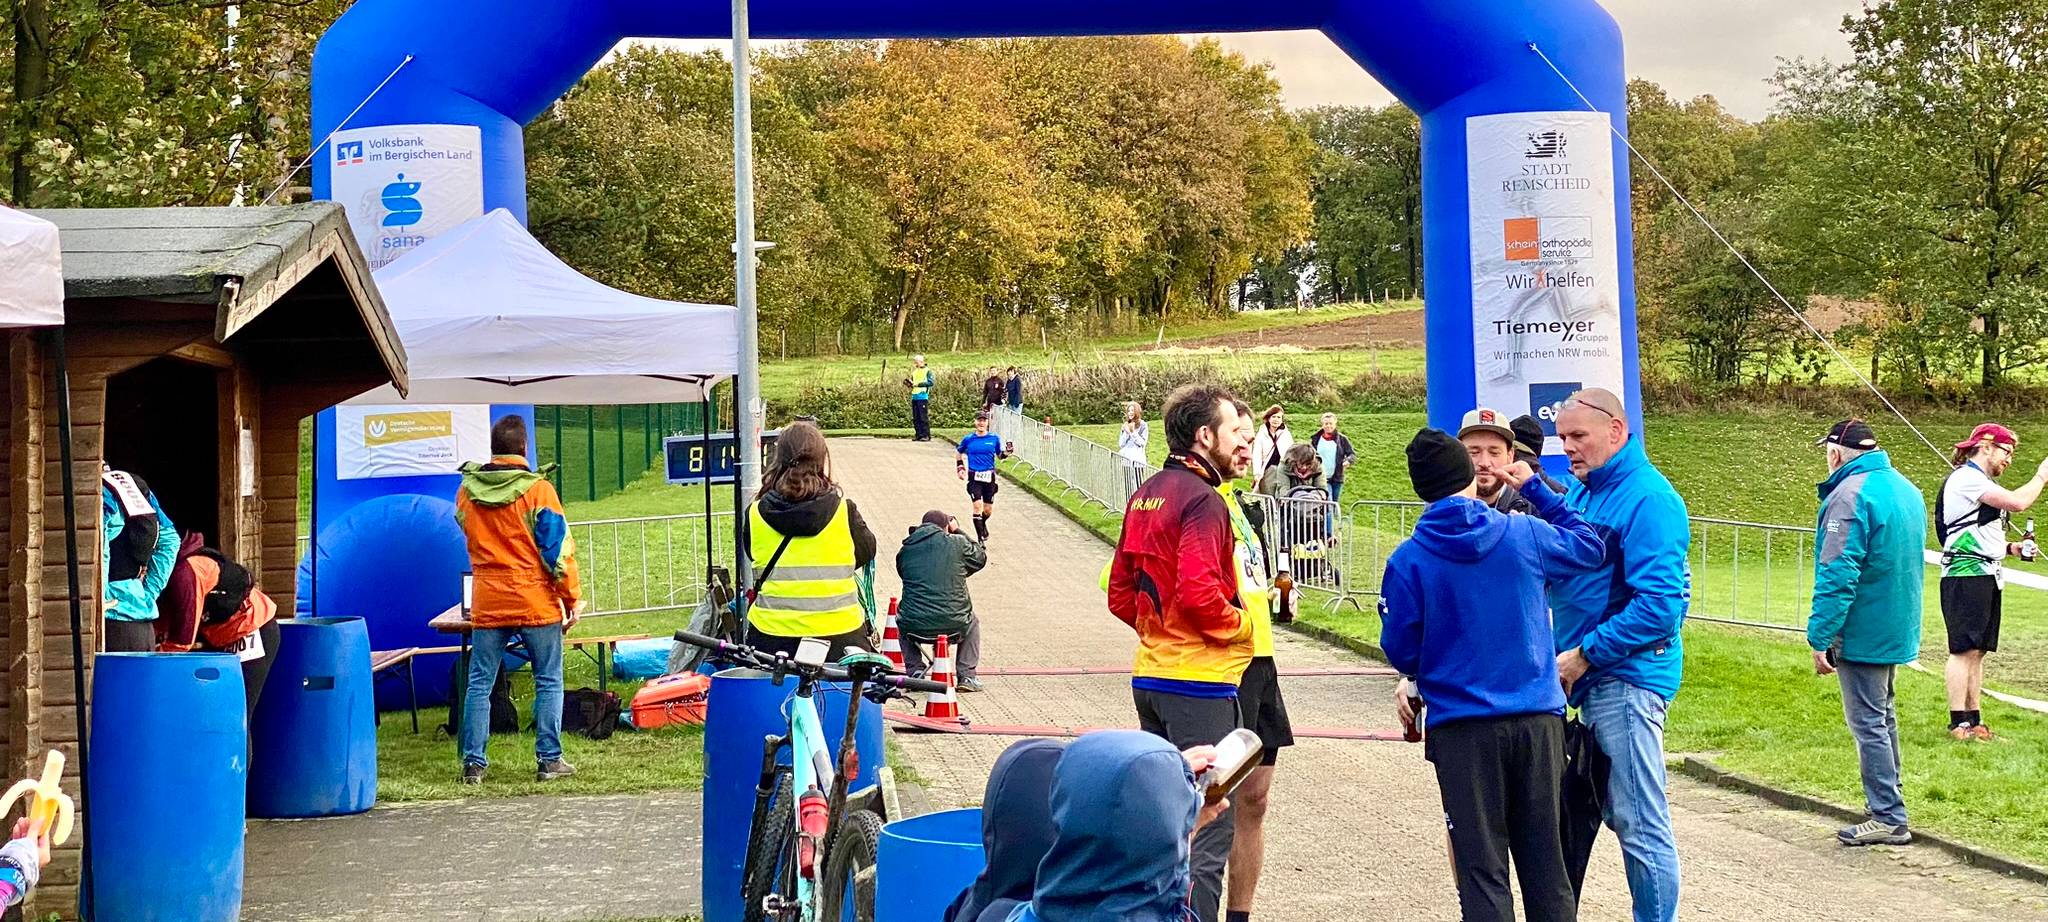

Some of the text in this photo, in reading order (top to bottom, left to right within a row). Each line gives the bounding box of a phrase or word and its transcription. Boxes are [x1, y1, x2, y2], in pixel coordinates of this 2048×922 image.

[369, 136, 424, 149] Volksbank
[369, 149, 472, 162] im Bergischen Land
[1521, 163, 1571, 177] STADT
[1502, 177, 1591, 193] REMSCHEID
[382, 236, 425, 248] sana
[1506, 239, 1538, 250] schein
[1542, 248, 1572, 258] service
[1505, 271, 1595, 289] Wir helfen
[1492, 320, 1595, 342] Tiemeyer
[1575, 333, 1609, 344] Gruppe
[1493, 347, 1610, 360] Wir machen NRW mobil.
